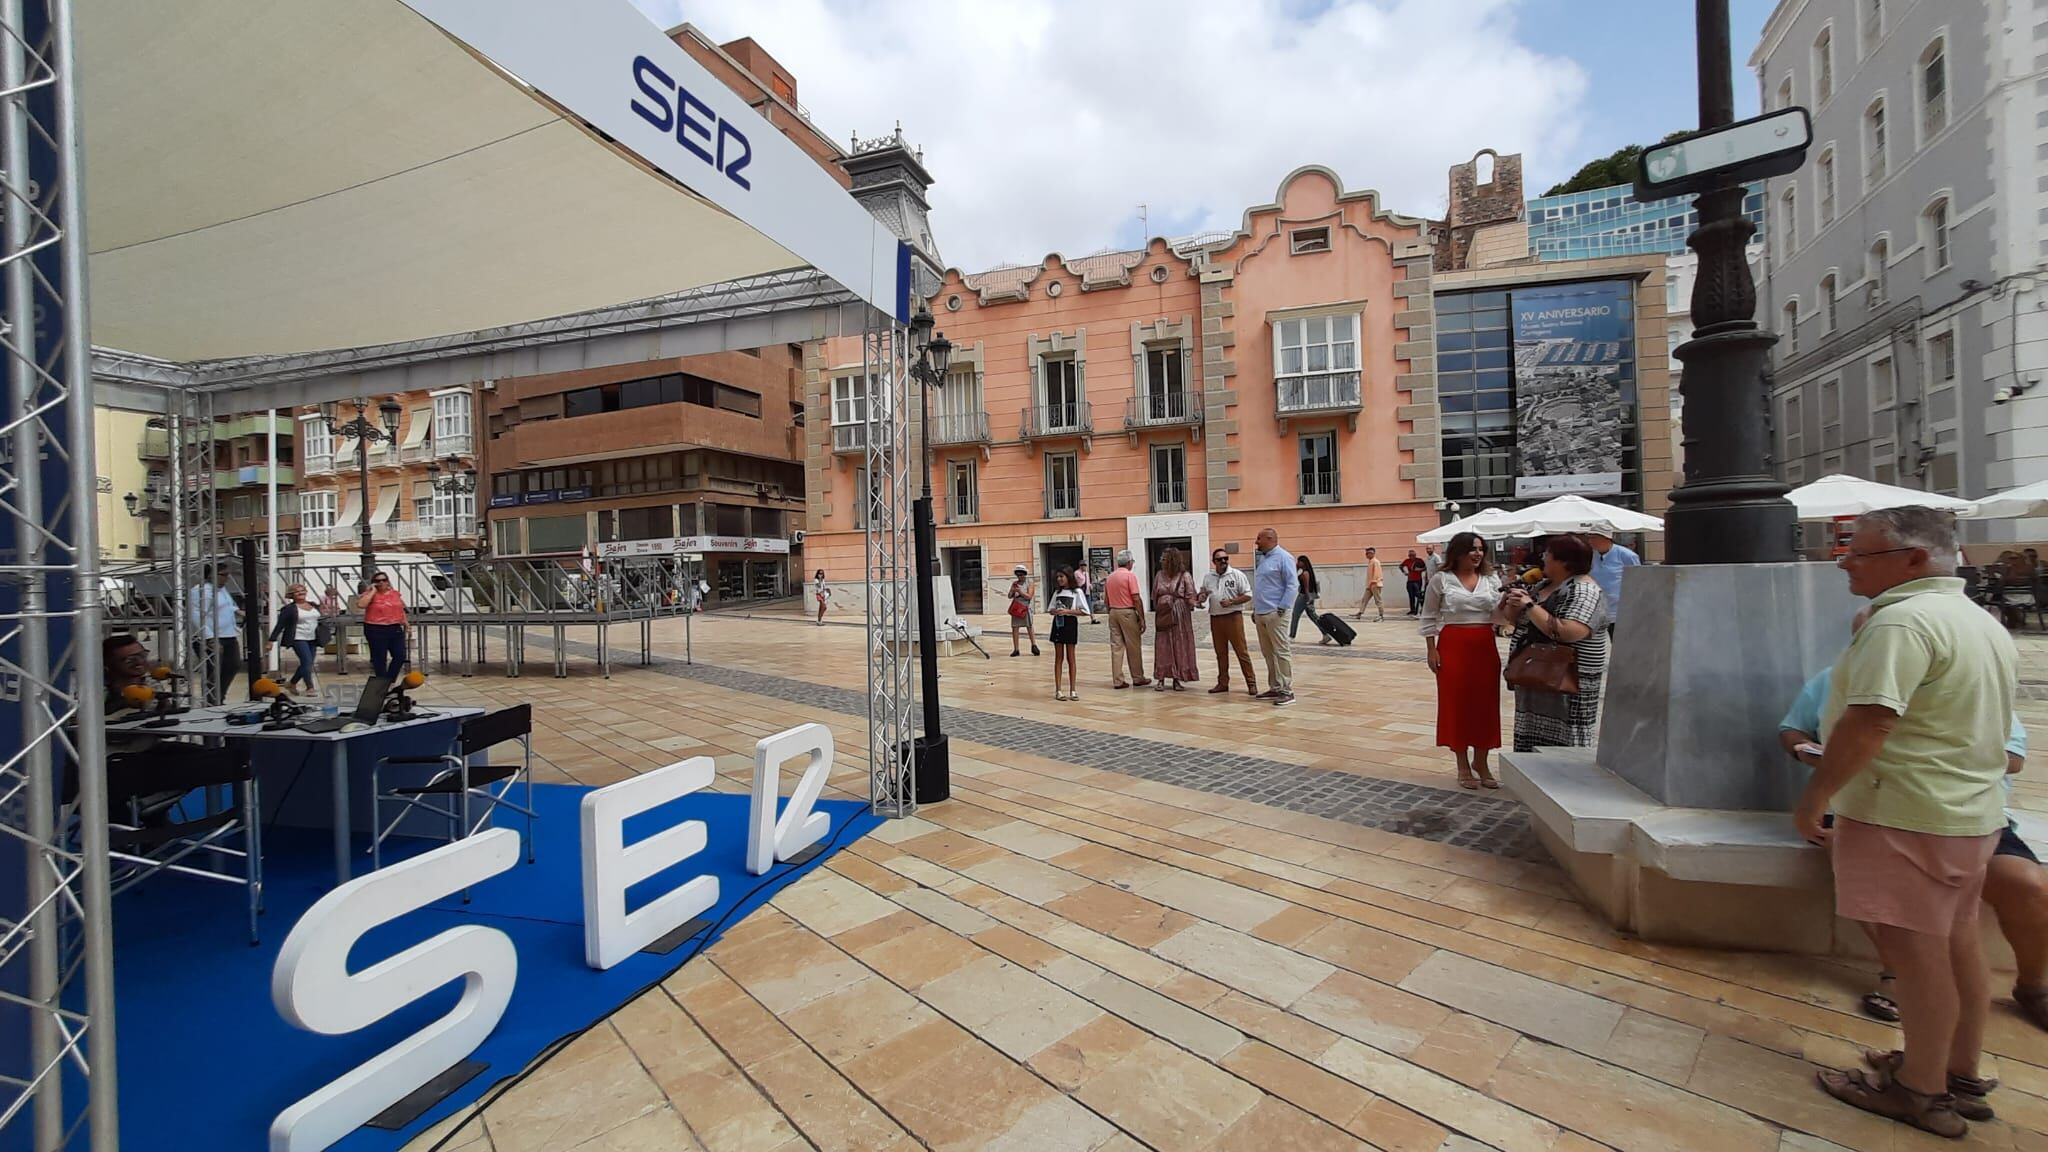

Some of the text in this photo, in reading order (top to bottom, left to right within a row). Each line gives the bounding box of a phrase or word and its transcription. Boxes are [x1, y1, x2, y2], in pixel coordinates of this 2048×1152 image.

[630, 55, 752, 191] SER
[1520, 305, 1610, 321] XV ANIVERSARIO
[268, 722, 835, 1152] SER
